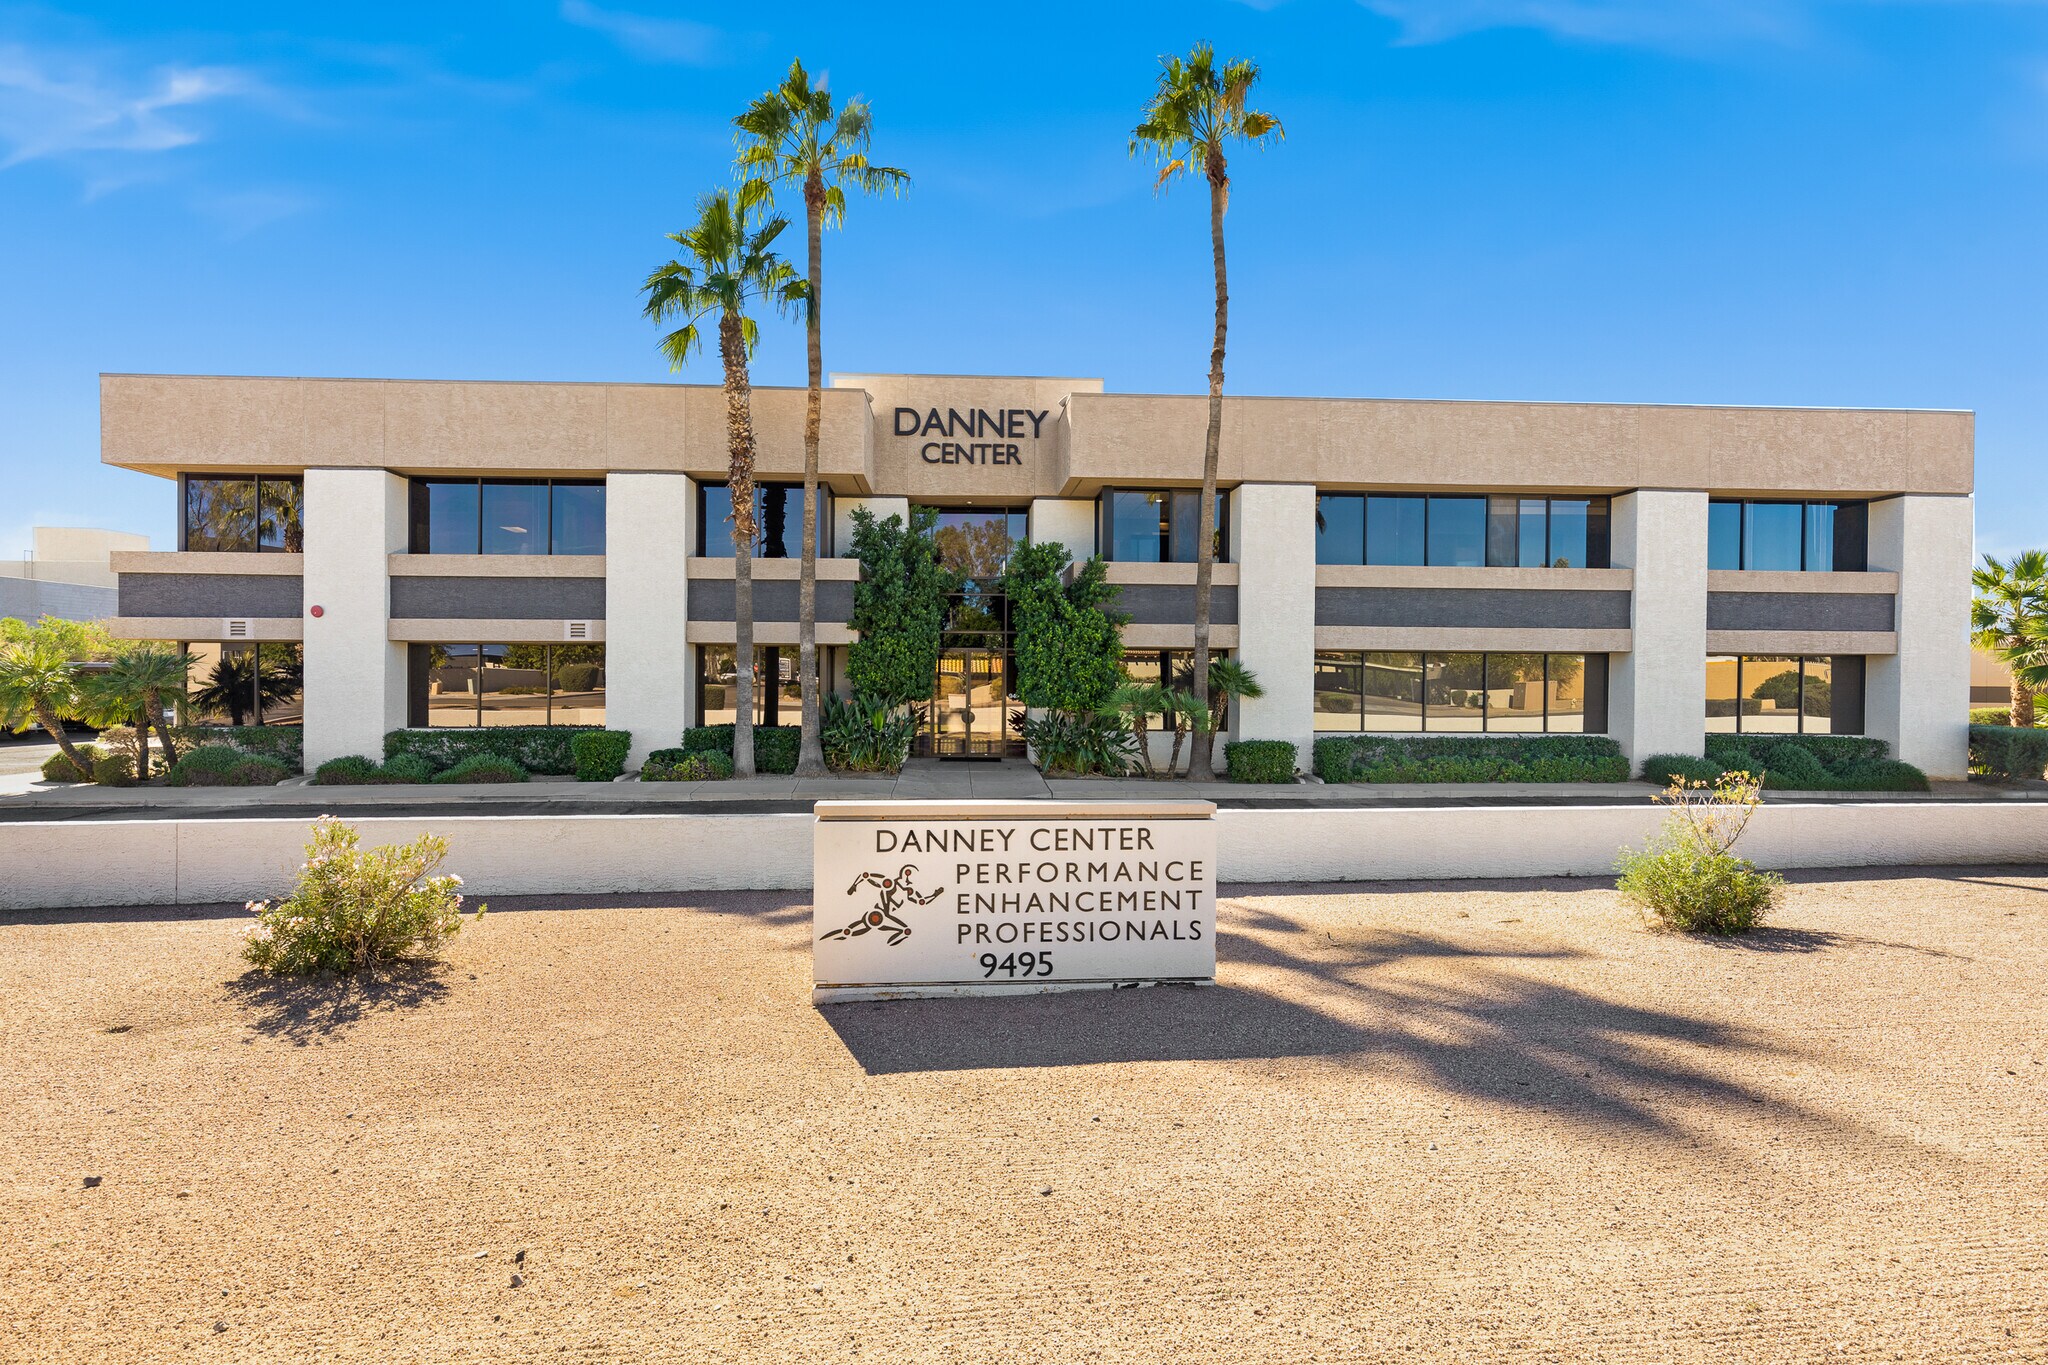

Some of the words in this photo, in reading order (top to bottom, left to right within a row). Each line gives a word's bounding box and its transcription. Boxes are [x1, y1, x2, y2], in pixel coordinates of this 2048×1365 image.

[894, 407, 1049, 439] DANNEY
[921, 442, 1022, 465] CENTER
[876, 829, 1015, 852] DANNEY
[1030, 828, 1154, 851] CENTER
[957, 861, 1203, 884] PERFORMANCE
[957, 890, 1203, 914] ENHANCEMENT
[957, 919, 1202, 944] PROFESSIONALS
[979, 950, 1054, 979] 9495
